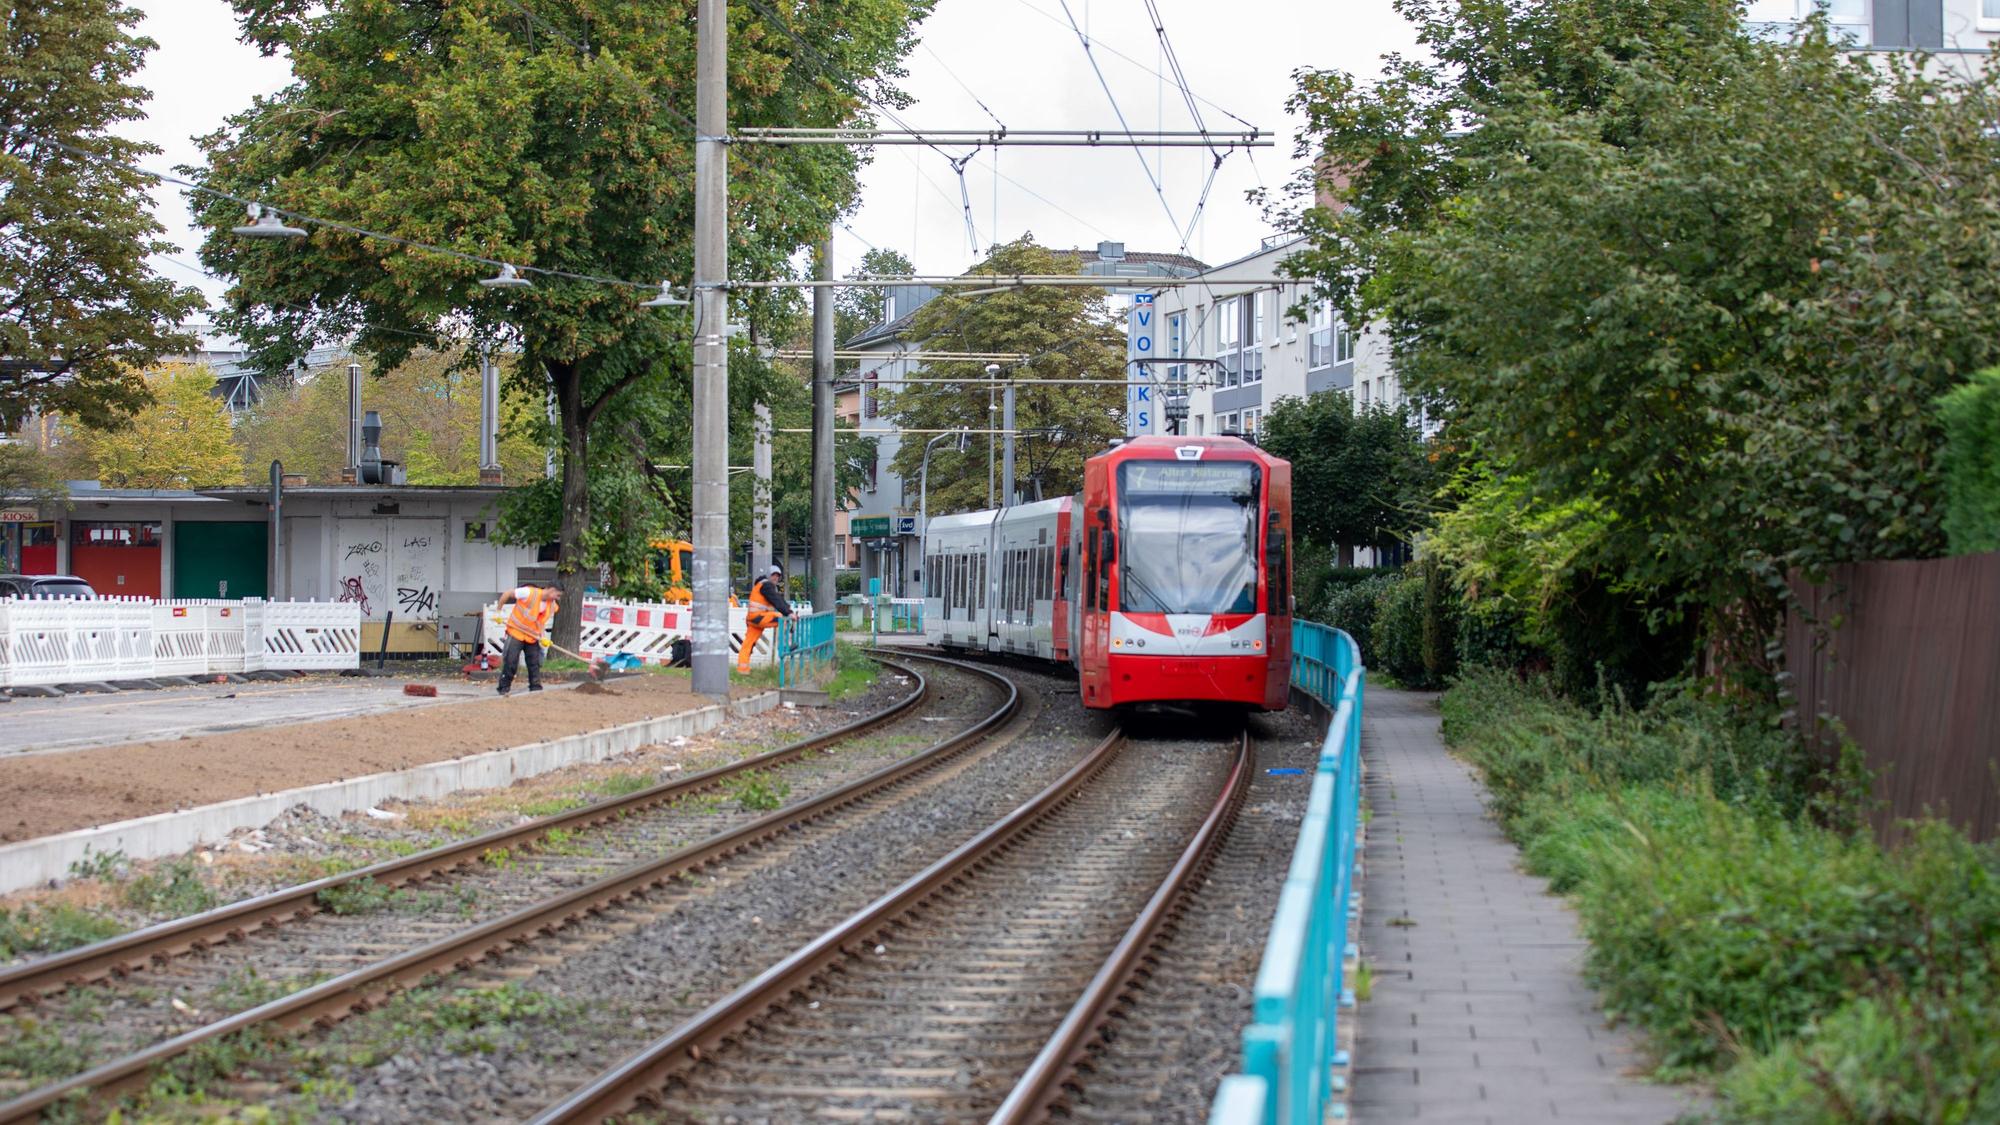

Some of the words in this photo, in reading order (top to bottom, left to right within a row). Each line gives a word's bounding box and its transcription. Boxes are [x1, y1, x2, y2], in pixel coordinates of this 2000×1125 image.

[1137, 311, 1152, 428] VOLKS
[1135, 466, 1147, 489] 7
[3, 512, 34, 520] KIOSK
